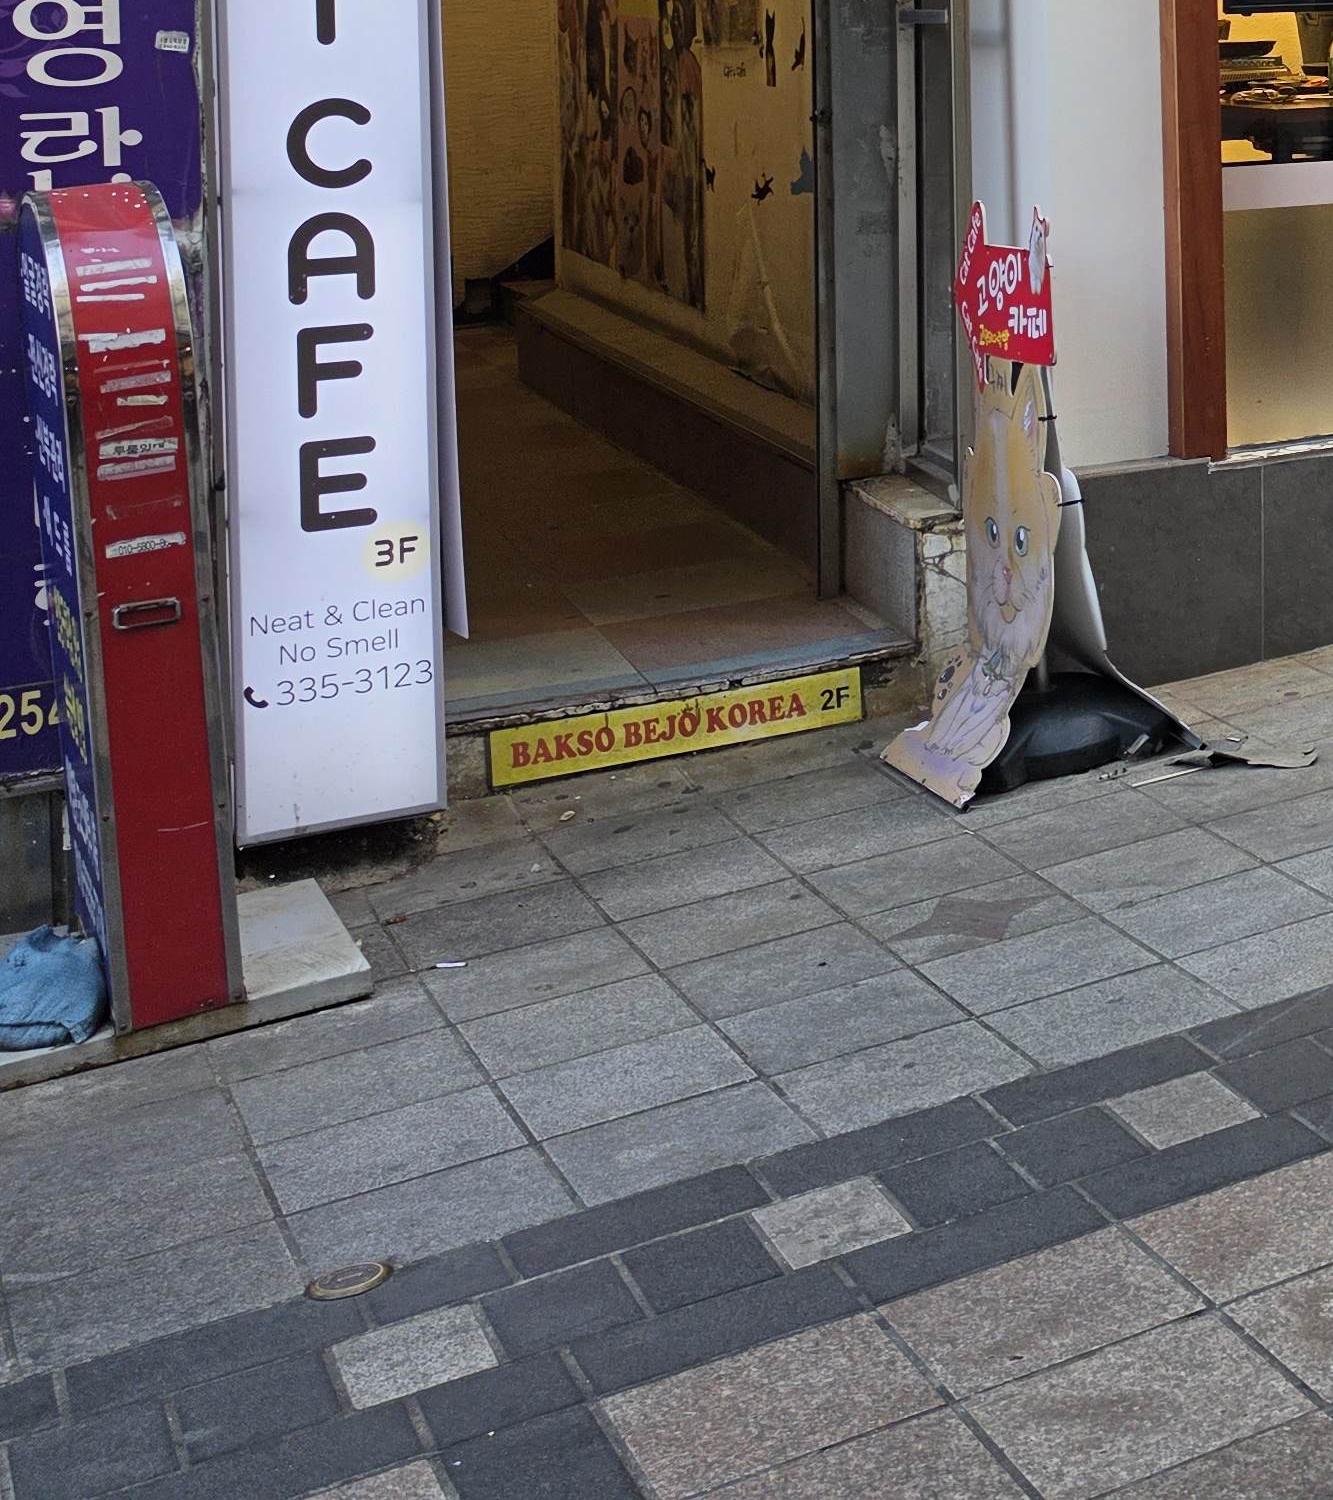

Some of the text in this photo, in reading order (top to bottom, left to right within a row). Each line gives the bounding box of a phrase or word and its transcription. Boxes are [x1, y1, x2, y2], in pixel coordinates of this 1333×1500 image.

[976, 251, 1022, 317] 고양이
[286, 97, 379, 534] CAFE
[1007, 304, 1047, 339] 카페
[374, 535, 419, 567] 3F
[250, 592, 426, 638] Neat & Clean
[279, 627, 400, 667] No Smell
[275, 659, 434, 708] 335-3123
[510, 686, 851, 770] BAKSO BEJO KOREA 2F
